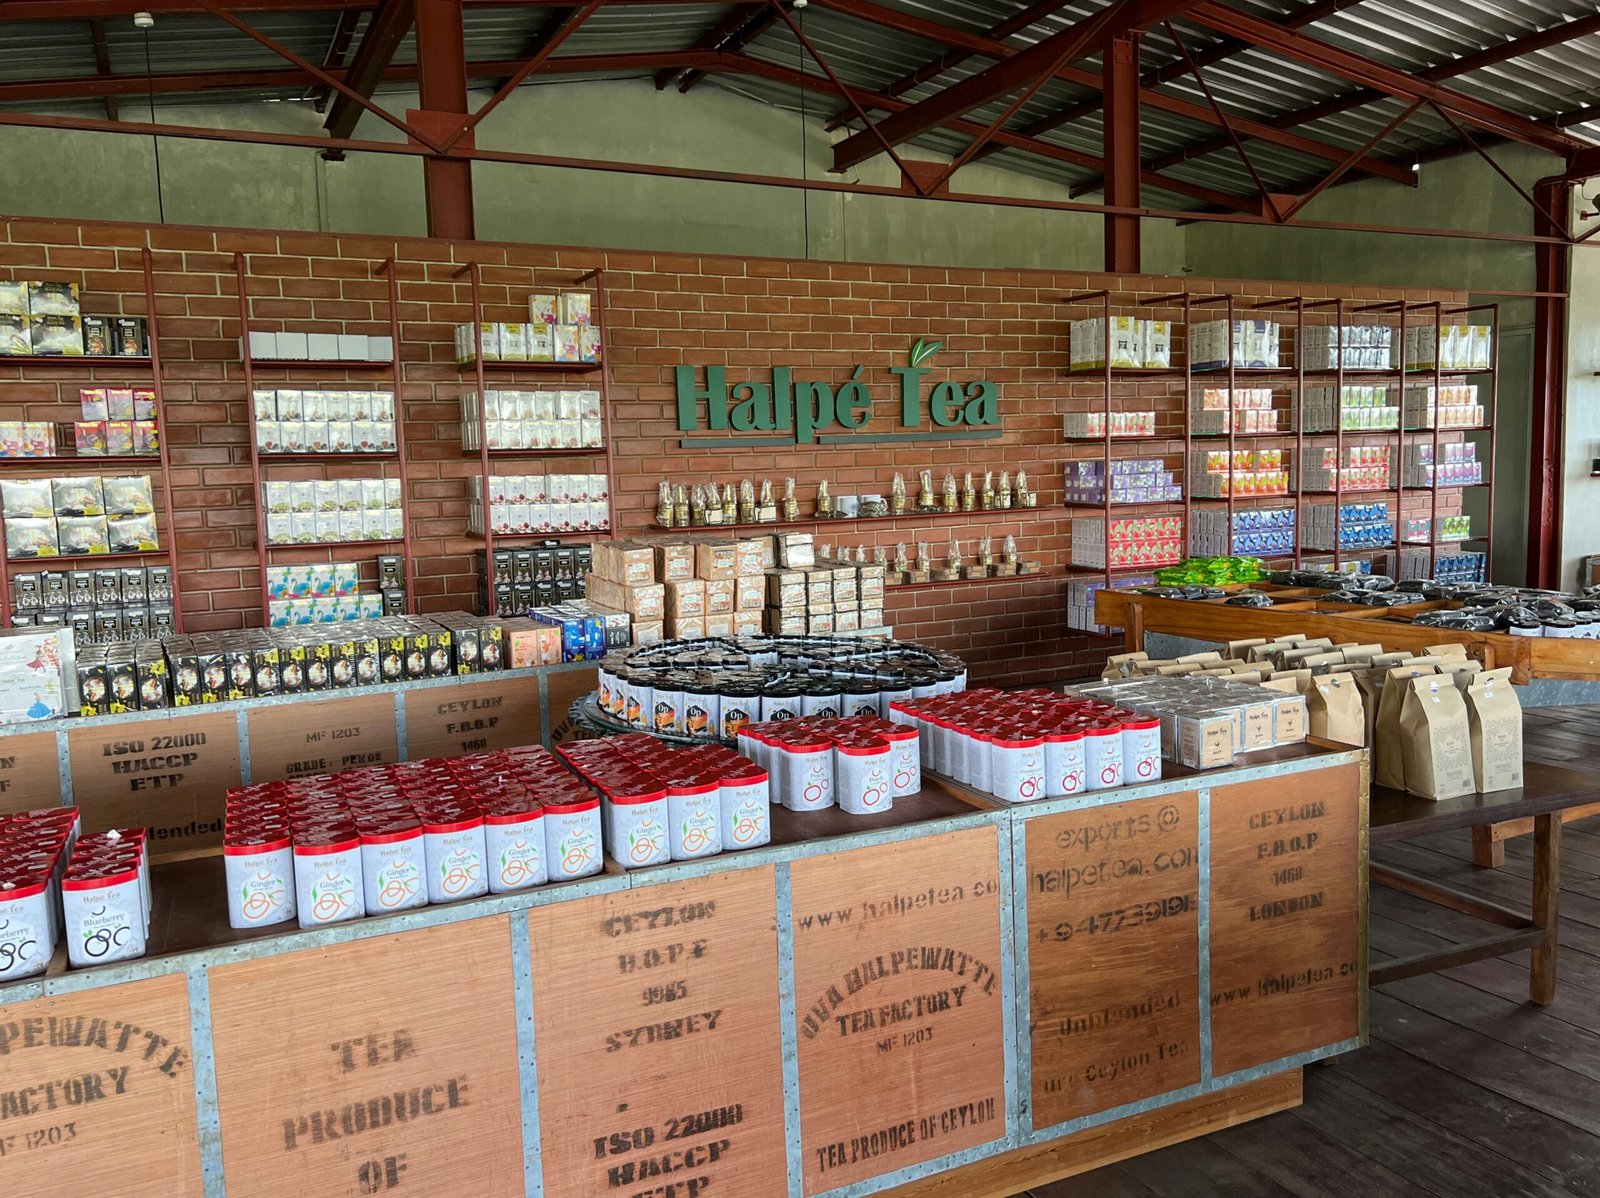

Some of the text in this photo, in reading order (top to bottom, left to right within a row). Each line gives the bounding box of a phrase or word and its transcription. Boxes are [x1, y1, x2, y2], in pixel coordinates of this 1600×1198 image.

[674, 364, 1001, 444] Halpé Tea
[437, 696, 503, 714] CEYLON
[657, 705, 669, 714] Op
[690, 708, 702, 717] Op
[730, 711, 743, 720] Op
[776, 711, 790, 720] Op
[822, 708, 834, 718] Op
[102, 732, 207, 756] ISO 22000
[305, 728, 360, 743] MF 1203
[111, 753, 199, 774] HACCP
[341, 752, 382, 766] PEKOE
[129, 773, 185, 791] ETP
[689, 816, 709, 825] Ginger
[740, 807, 759, 815] Ginger
[1249, 801, 1326, 829] CEYLON
[150, 818, 223, 840] lended
[567, 835, 589, 845] Ginger
[636, 826, 657, 834] Ginger
[1056, 804, 1180, 852] exports @
[448, 854, 472, 864] Ginger
[508, 846, 531, 856] Ginger
[386, 866, 410, 877] Ginger
[250, 879, 276, 889] Ginger
[319, 879, 345, 889] Ginger
[602, 900, 717, 937] CEYLON
[798, 908, 853, 931] www
[863, 885, 964, 921] halpetea
[1249, 892, 1324, 922] LONDON
[84, 913, 125, 926] Blueberry
[801, 946, 998, 1040] UVA HALPEWATTE
[836, 985, 967, 1037] TEA FACTORY
[1060, 989, 1181, 1036] Unblended
[606, 1009, 723, 1053] SYDNEY
[876, 1026, 933, 1054] MF 1203
[0, 1016, 188, 1078] PEWATTE
[331, 1028, 418, 1074] TEA
[1085, 1050, 1151, 1081] Ceylon
[1156, 1040, 1189, 1060] Tea
[0, 1065, 130, 1120] ACTORY
[282, 1074, 470, 1150] PRODUCE
[25, 1122, 77, 1151] 1203
[593, 1103, 744, 1160] ISO 22000
[816, 1097, 995, 1172] TEA PRODUCE OF CEYLON
[358, 1152, 408, 1194] OF
[608, 1139, 731, 1189] HACCP
